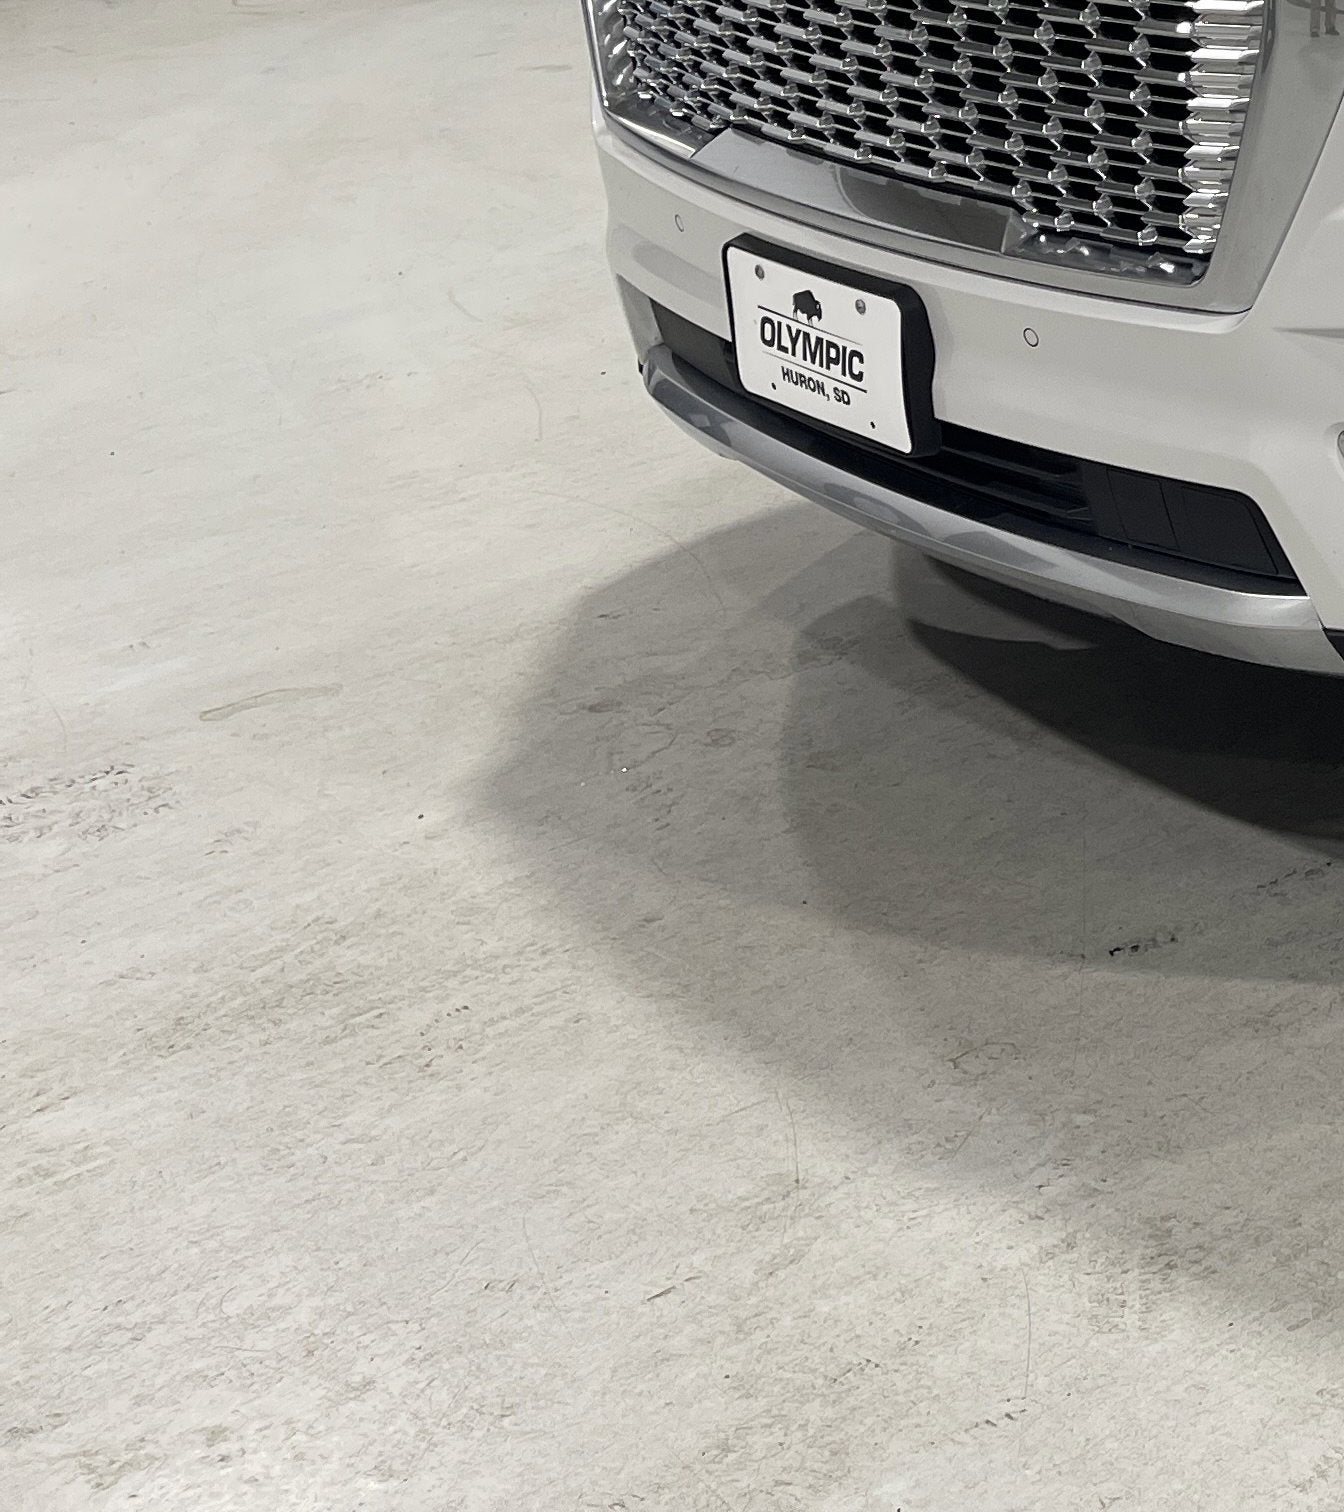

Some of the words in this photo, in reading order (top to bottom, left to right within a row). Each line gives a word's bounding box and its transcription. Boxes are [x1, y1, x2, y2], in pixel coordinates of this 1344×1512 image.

[760, 315, 865, 383] OLYMPIC
[781, 365, 831, 402] HURON,
[833, 386, 851, 406] SD
